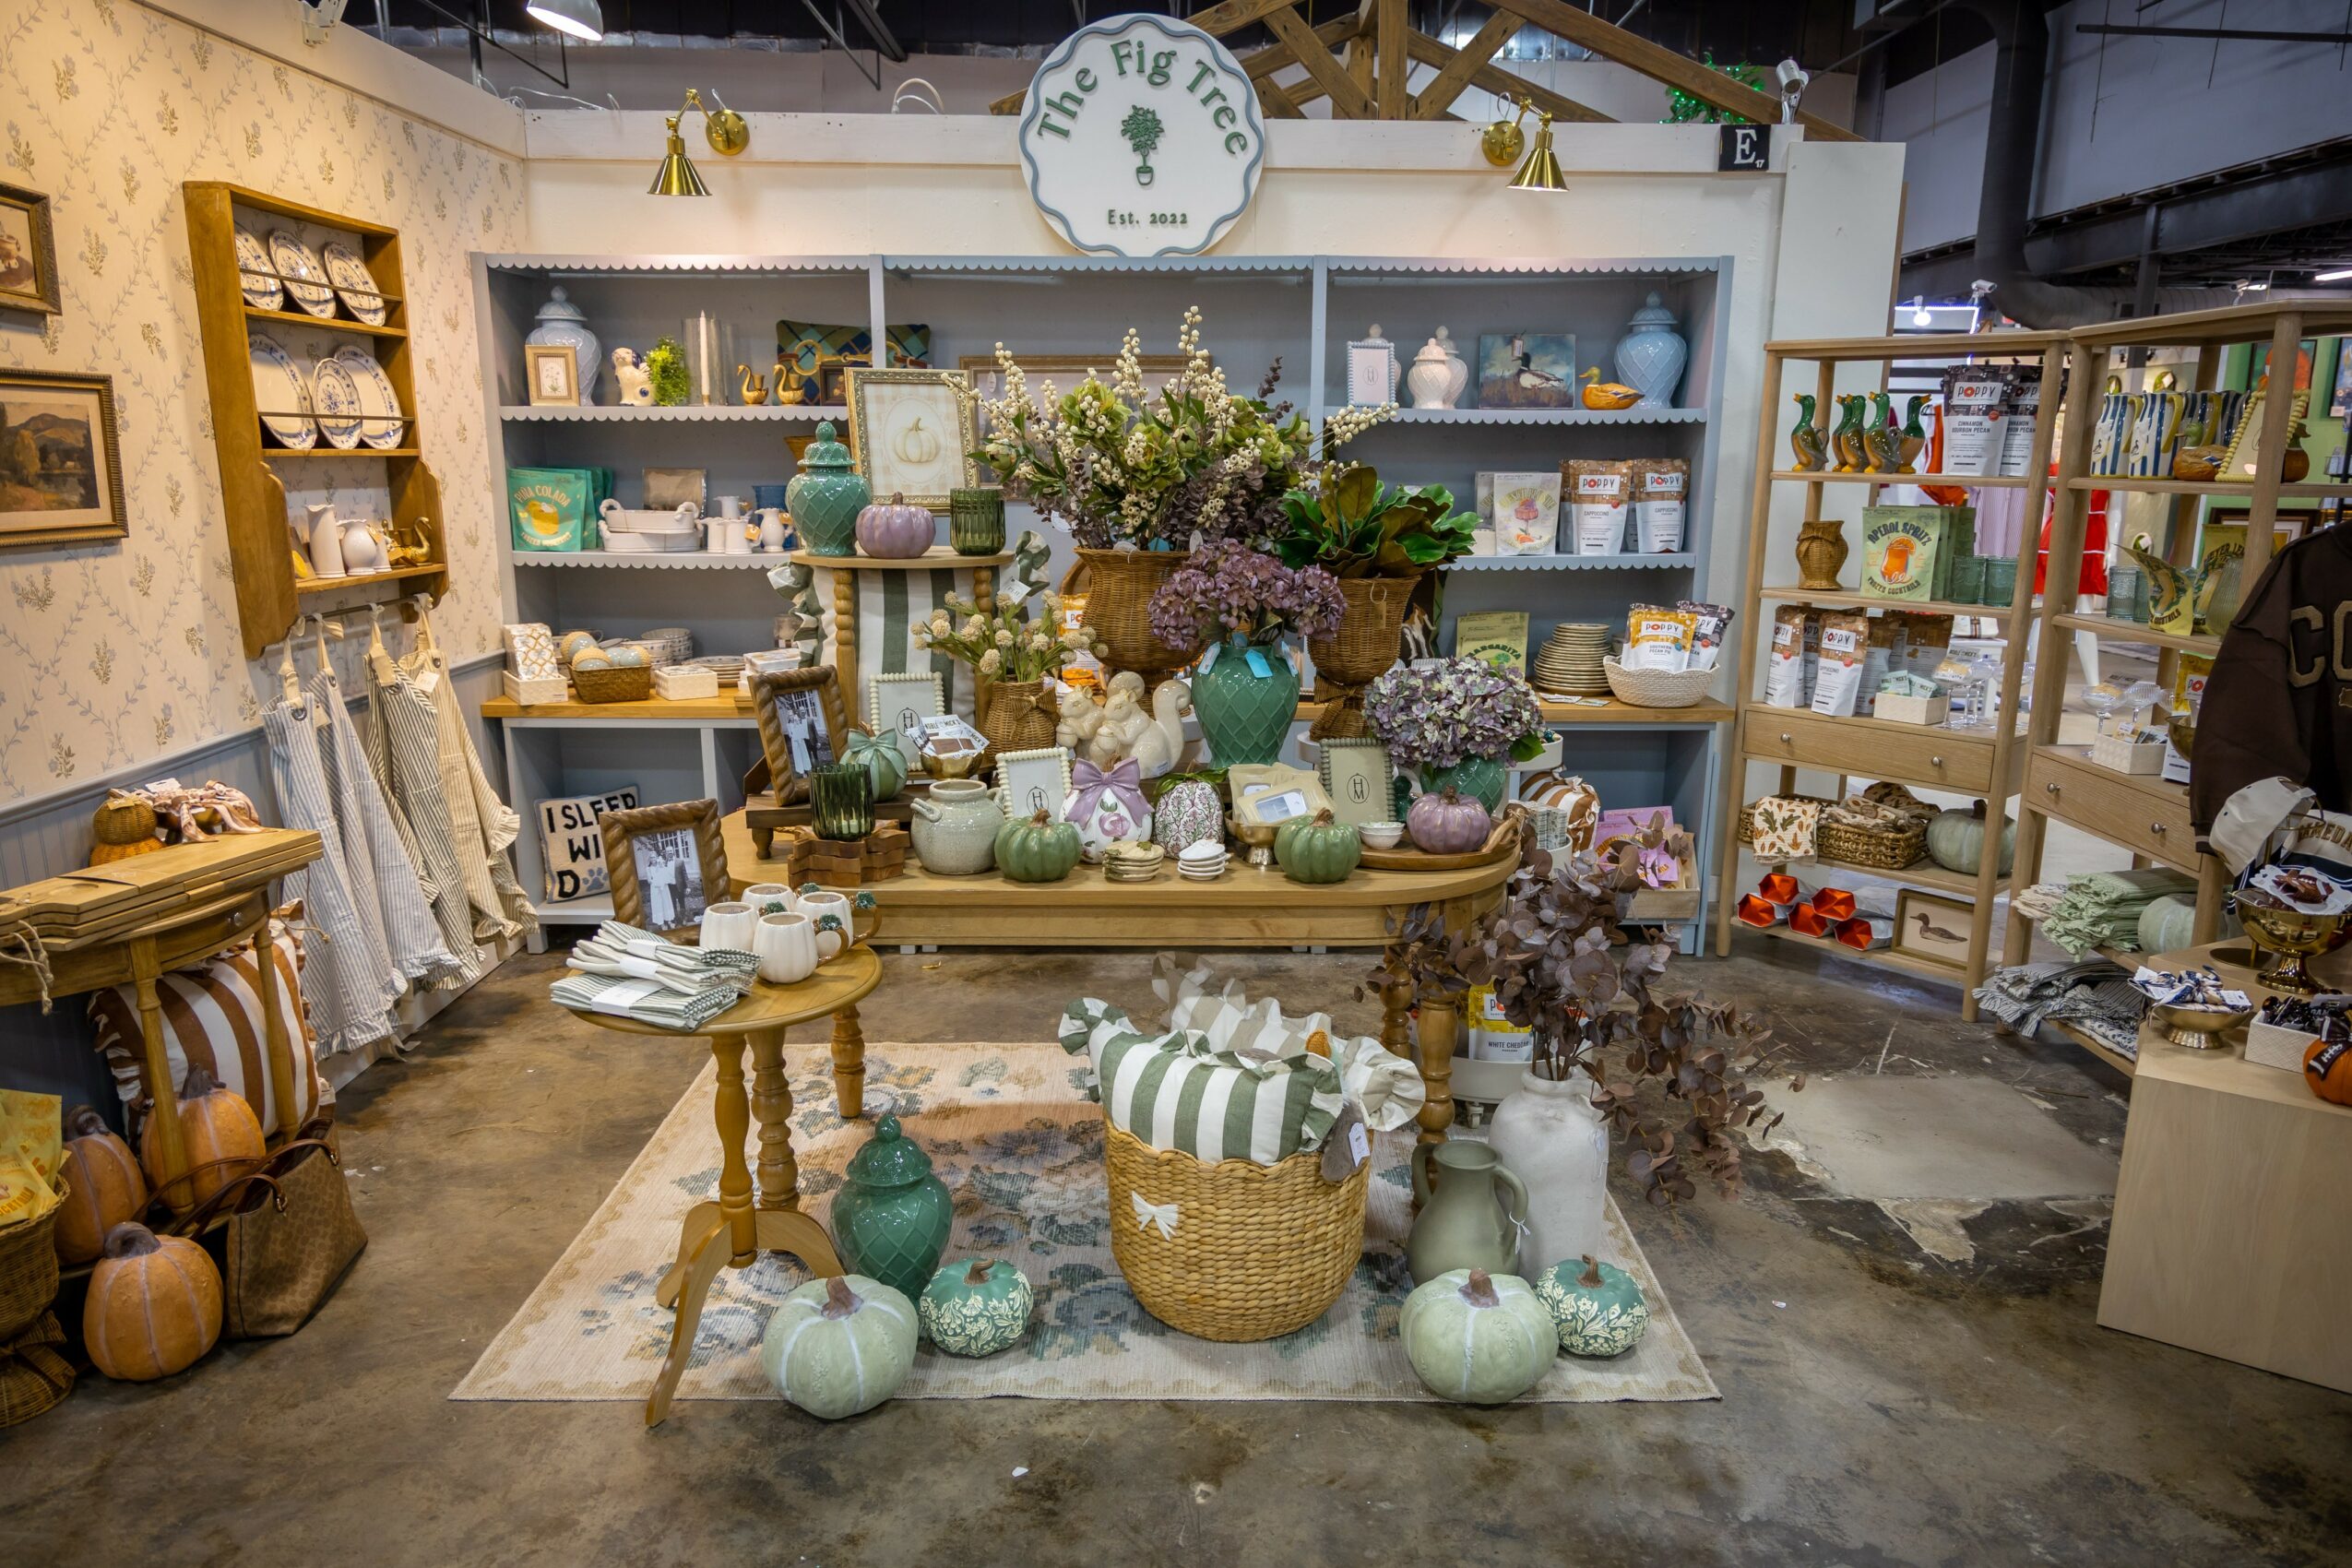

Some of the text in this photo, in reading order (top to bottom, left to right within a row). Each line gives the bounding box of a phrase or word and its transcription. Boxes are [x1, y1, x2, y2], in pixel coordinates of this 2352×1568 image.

[1037, 39, 1248, 155] The Fig Tree
[1734, 129, 1757, 164] E
[1108, 209, 1187, 224] Est. 2022
[1957, 386, 1996, 398] POPPY
[2014, 386, 2038, 398] OPP
[1583, 479, 1615, 488] POPPY
[1650, 476, 1680, 485] POPPY
[535, 485, 571, 507] COLADA
[1867, 521, 1932, 546] APEROL SPRITZ
[1887, 579, 1920, 595] COCKTAILS
[1645, 624, 1679, 632] POPPY
[1823, 631, 1850, 645] POPPY
[546, 807, 555, 833] I
[567, 833, 600, 863] WI
